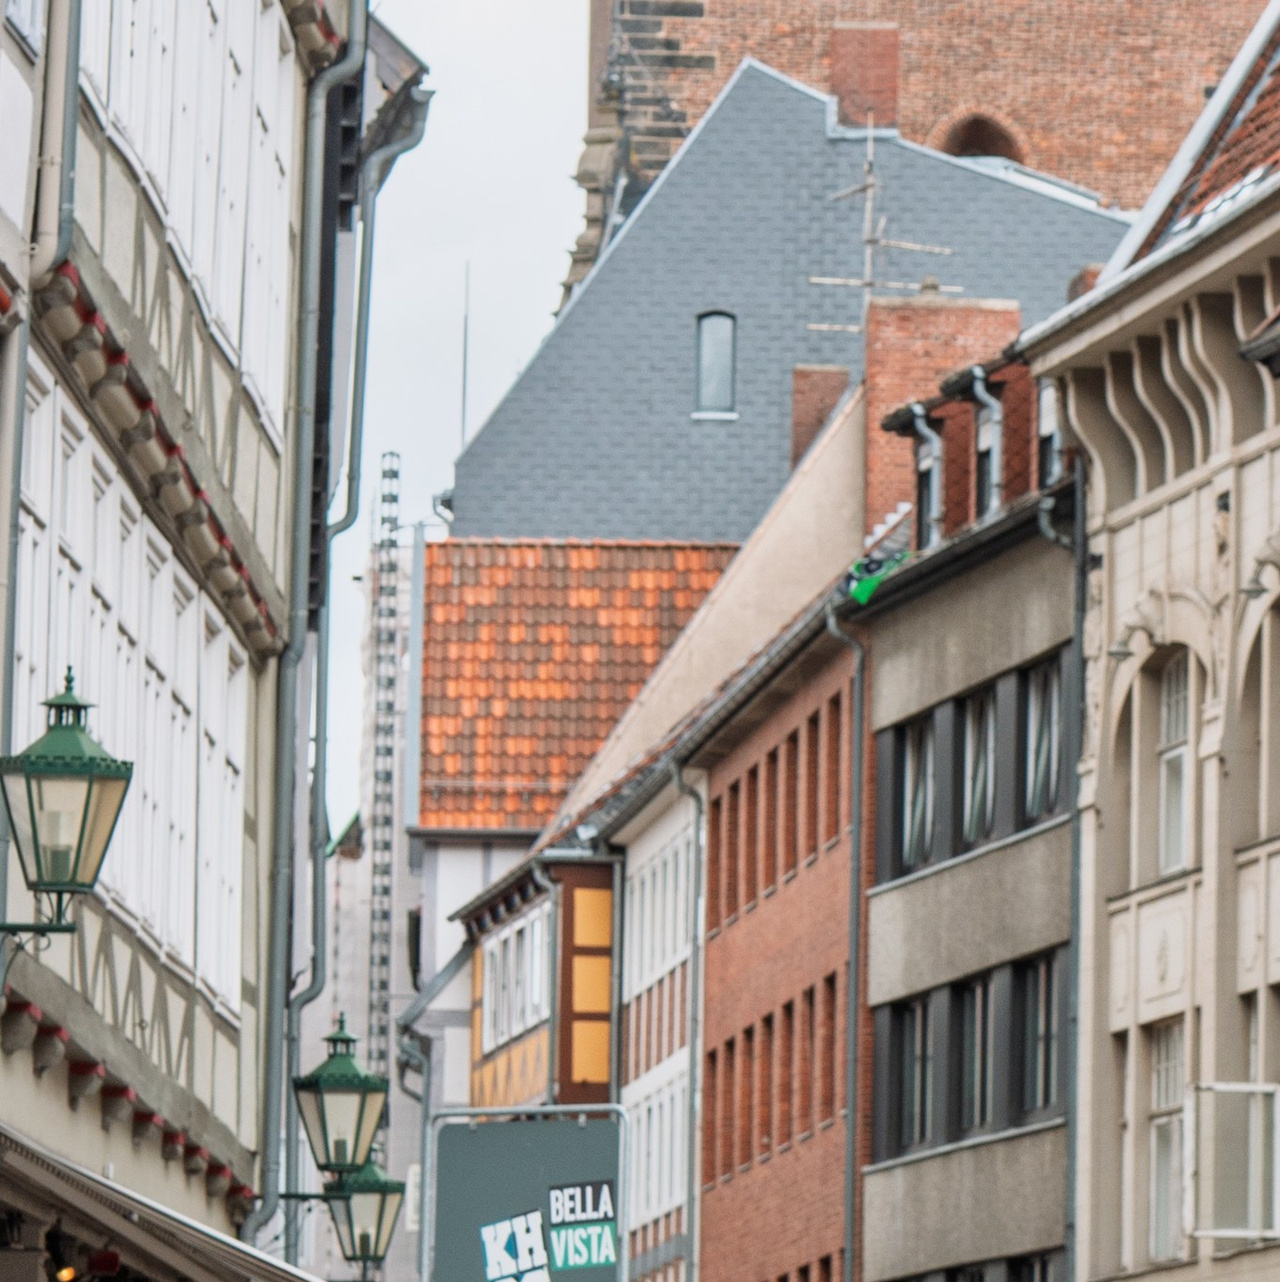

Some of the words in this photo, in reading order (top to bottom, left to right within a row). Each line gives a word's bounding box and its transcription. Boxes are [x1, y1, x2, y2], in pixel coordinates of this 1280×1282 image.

[550, 1184, 614, 1224] BELLA
[481, 1210, 548, 1281] KH
[550, 1225, 617, 1268] VISTA
